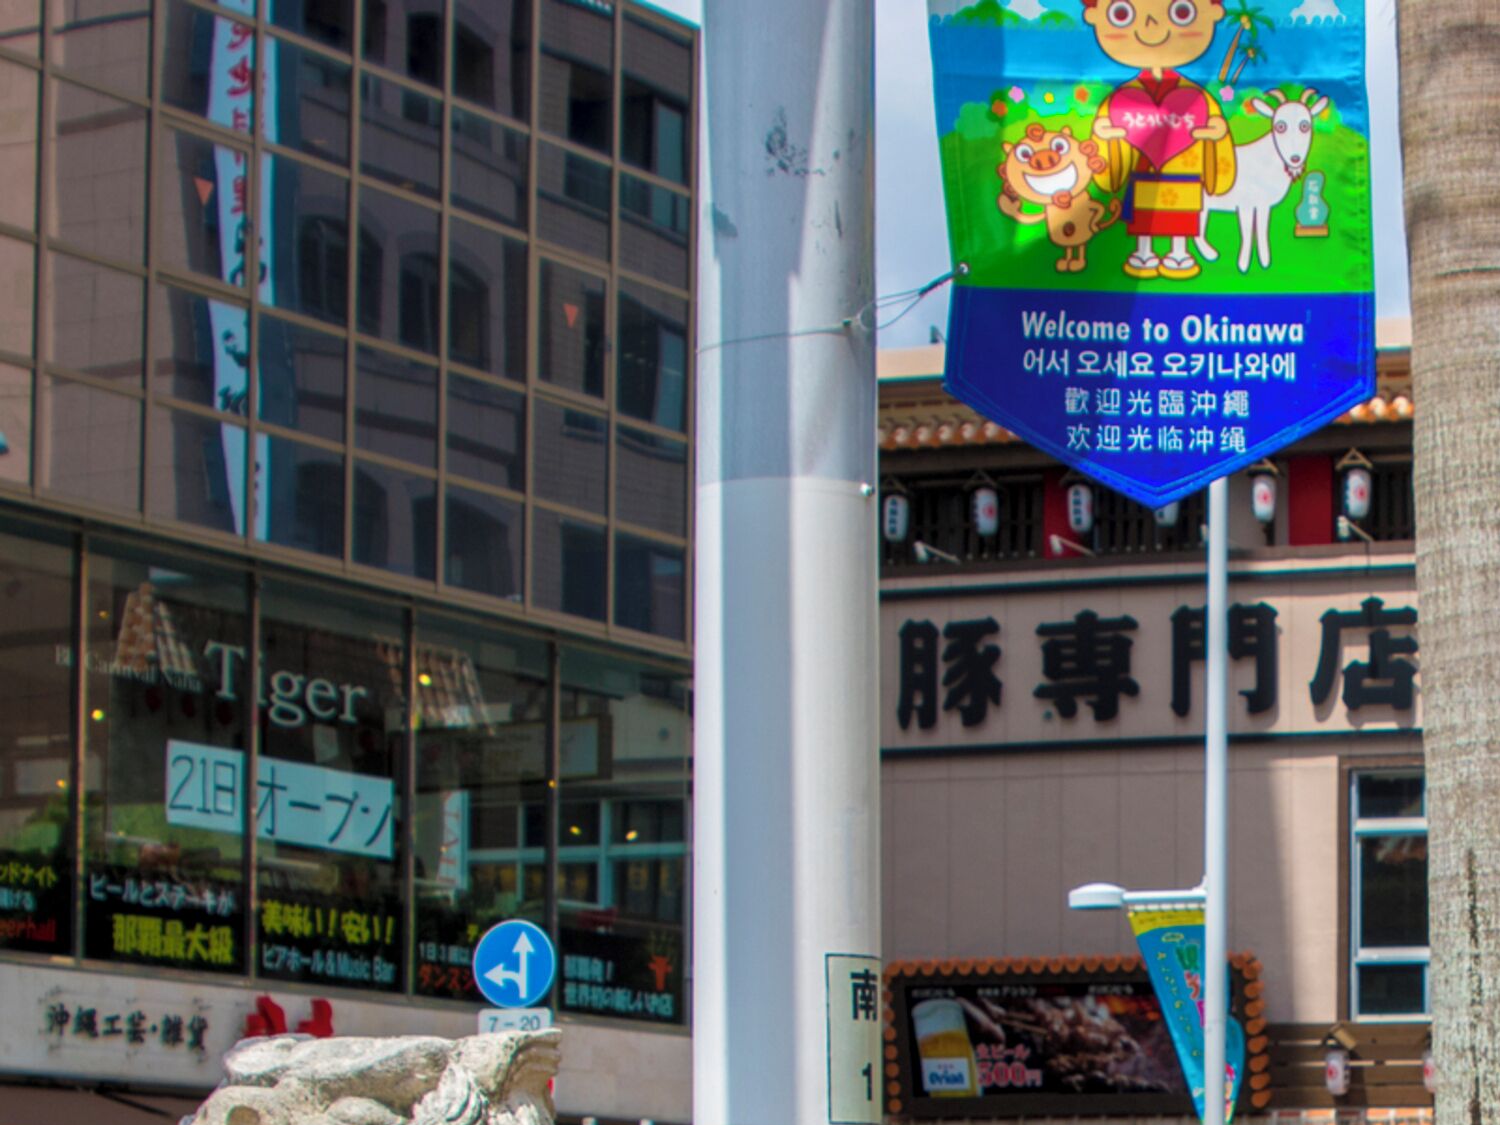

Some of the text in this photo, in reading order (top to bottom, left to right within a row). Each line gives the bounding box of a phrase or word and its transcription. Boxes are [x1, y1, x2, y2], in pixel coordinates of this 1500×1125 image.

[1021, 310, 1304, 342] Welcome to Okinawa
[1023, 348, 1296, 381] 어서 오세요 오키나와에
[1064, 387, 1249, 416] 歡迎光臨沖繩
[897, 597, 1418, 730] 豚専門店
[204, 640, 367, 727] Tiger
[850, 969, 877, 1021] 南
[862, 1063, 872, 1101] 1
